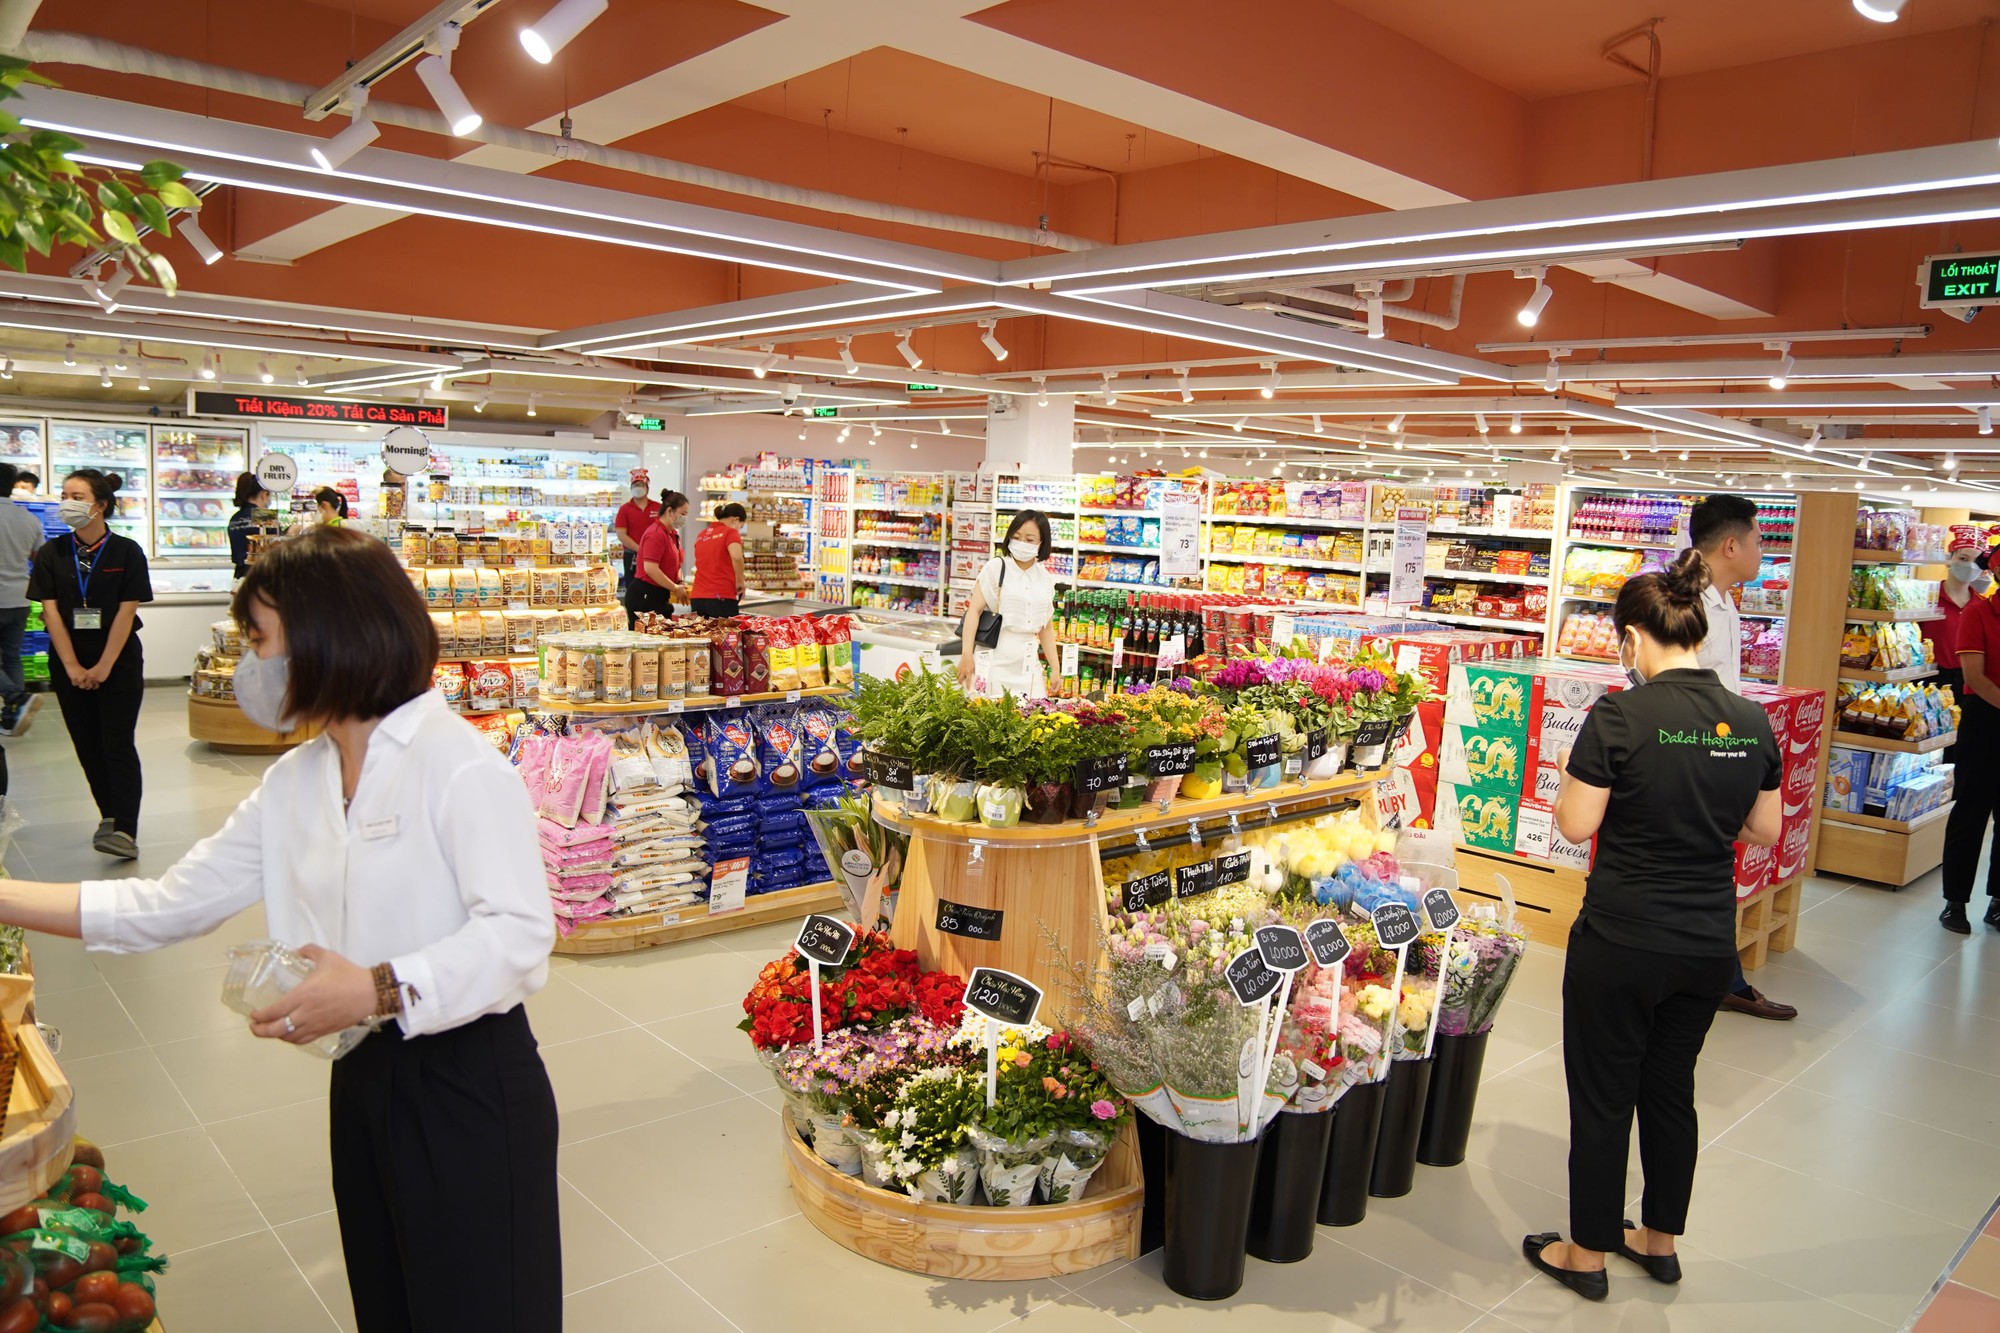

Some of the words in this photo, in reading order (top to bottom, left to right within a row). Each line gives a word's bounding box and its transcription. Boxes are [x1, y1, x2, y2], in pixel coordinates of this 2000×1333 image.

[1941, 263, 1958, 277] LỐI
[1961, 262, 1996, 276] THOÁT
[1944, 283, 1989, 296] EXIT
[266, 401, 303, 417] Kiệm
[306, 404, 337, 418] 20%
[385, 444, 428, 456] Morning!
[268, 465, 286, 473] DRY
[263, 472, 291, 481] FRUITS
[1180, 539, 1190, 549] 73
[1405, 562, 1416, 573] 175
[1432, 594, 1454, 604] RIESE
[482, 677, 506, 686] フルグラ
[1541, 711, 1583, 732] Budw
[1356, 733, 1371, 743] 60
[1659, 728, 1699, 745] Dalat
[1311, 744, 1320, 758] 60
[1252, 753, 1267, 764] 70
[1159, 760, 1174, 773] 60
[865, 767, 879, 780] 70
[885, 775, 897, 783] 000
[1086, 777, 1101, 790] 70
[1107, 774, 1118, 782] 000
[1526, 833, 1543, 842] 426
[1181, 881, 1195, 896] 40
[712, 893, 722, 901] 79
[1128, 893, 1145, 910] 65
[940, 915, 959, 930] 85
[968, 924, 983, 934] 000
[801, 930, 819, 947] 65
[1229, 966, 1249, 983] Sao
[972, 986, 999, 1006] 120
